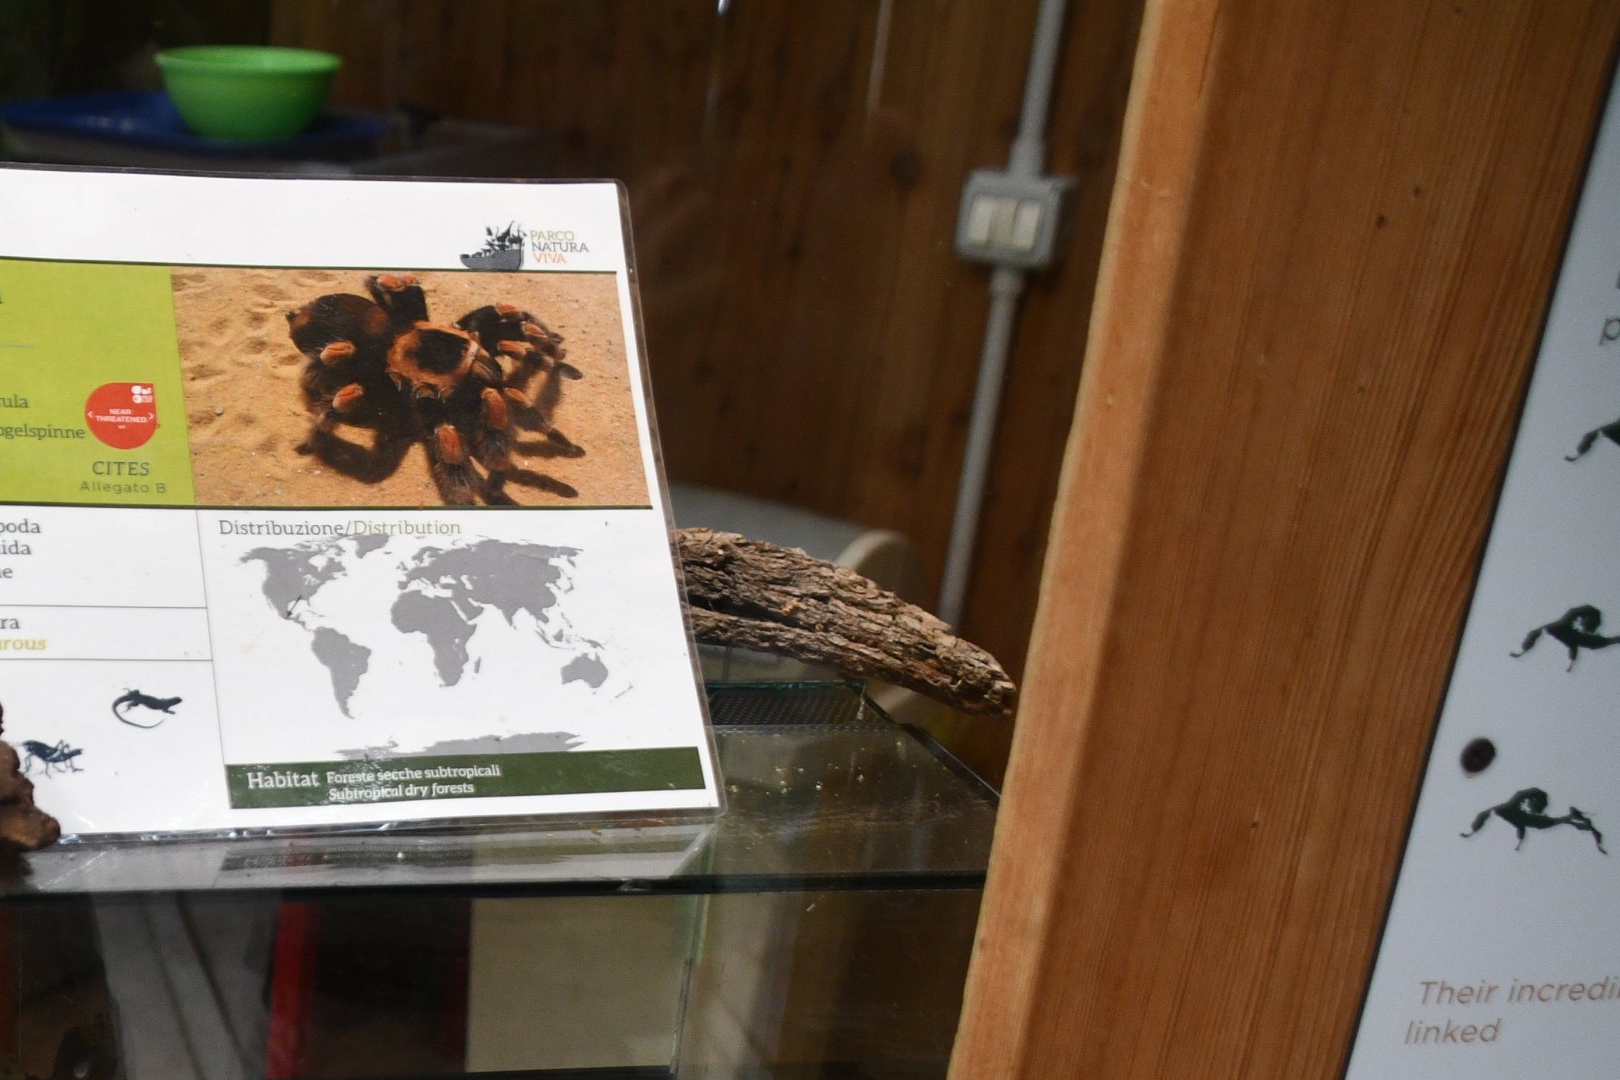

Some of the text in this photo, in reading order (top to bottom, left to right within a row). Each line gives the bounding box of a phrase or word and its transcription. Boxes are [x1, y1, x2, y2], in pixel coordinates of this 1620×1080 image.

[530, 230, 575, 242] PARCO
[531, 241, 589, 253] NATURA
[532, 252, 567, 264] VIVA
[94, 415, 148, 423] THREATENED
[92, 460, 150, 477] CITES
[80, 480, 167, 495] Allegato B
[246, 763, 501, 790] Habitat Foreste secche subtropicali
[328, 781, 475, 801] Subtropical dry forests
[1419, 975, 1620, 1005] Their incredi
[1404, 1017, 1502, 1045] linked
